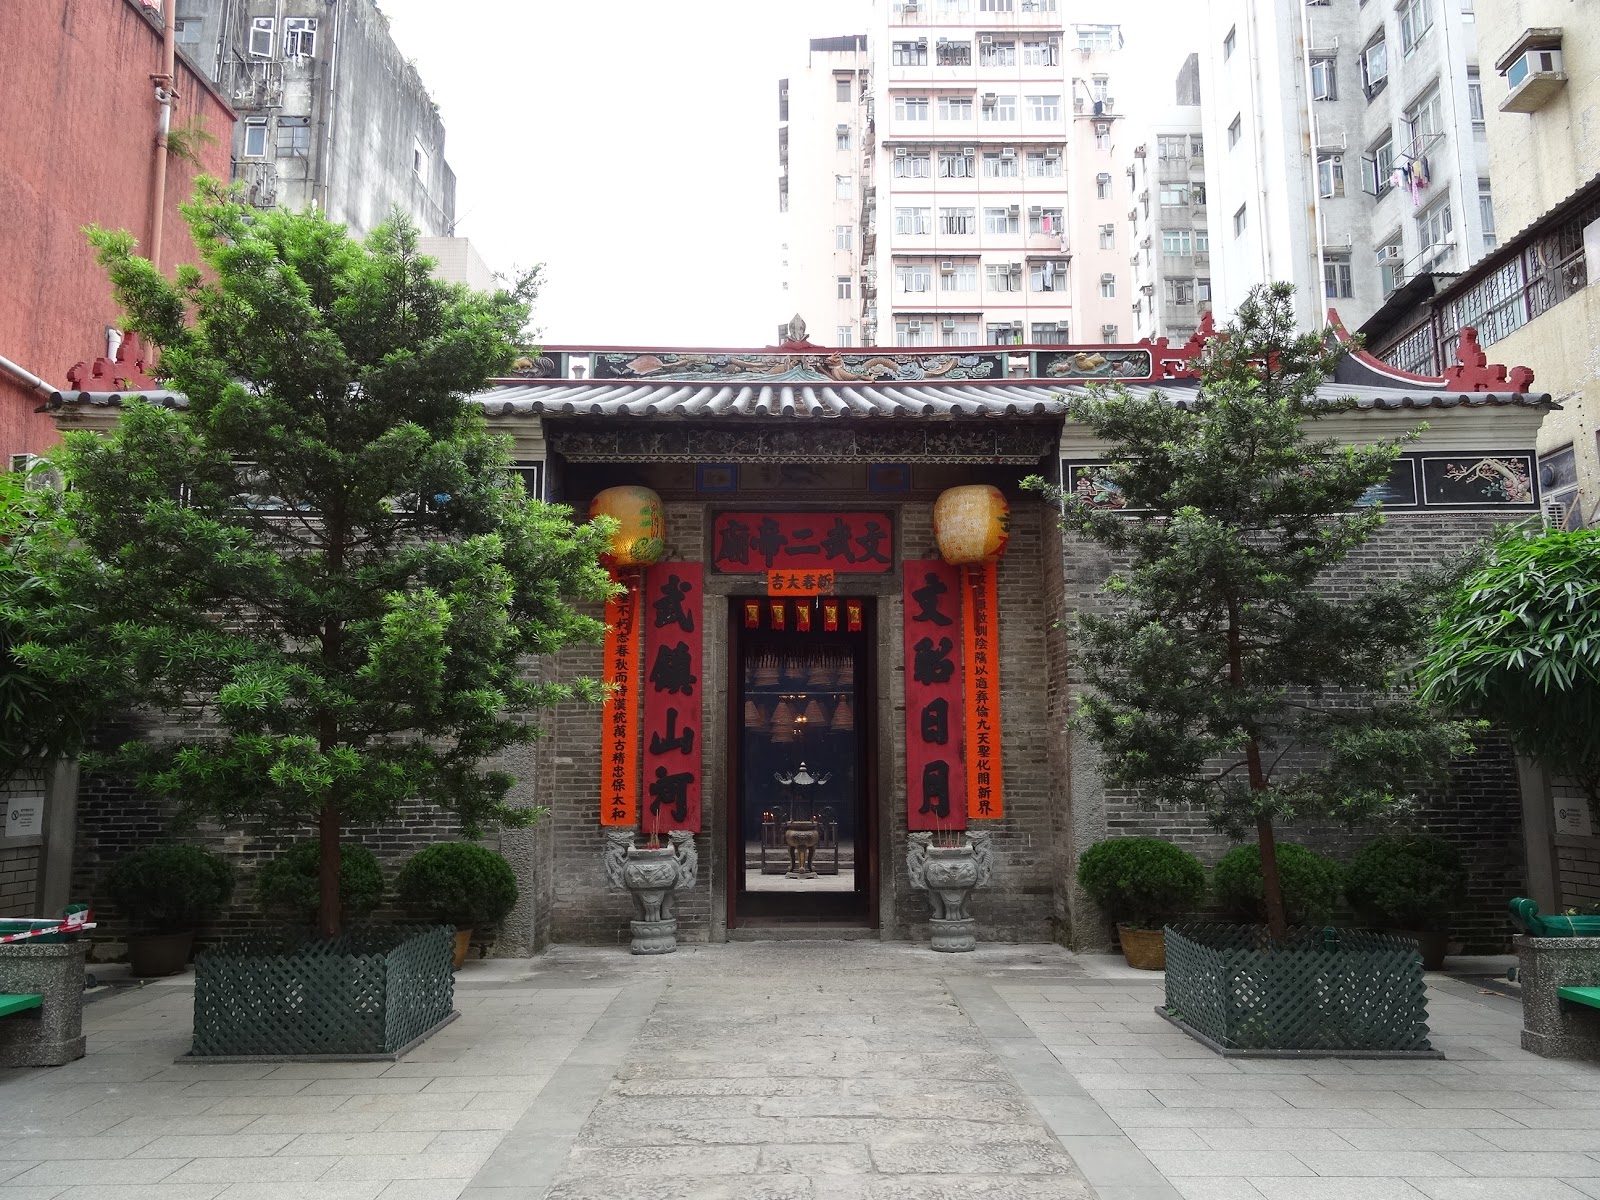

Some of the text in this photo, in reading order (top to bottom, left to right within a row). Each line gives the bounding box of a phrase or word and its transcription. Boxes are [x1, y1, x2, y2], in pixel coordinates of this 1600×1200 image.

[714, 516, 891, 568] 文武二帝廟
[771, 572, 833, 590] 新春大吉
[649, 574, 698, 823] 武鎮山河
[912, 572, 955, 818] 文昭日月
